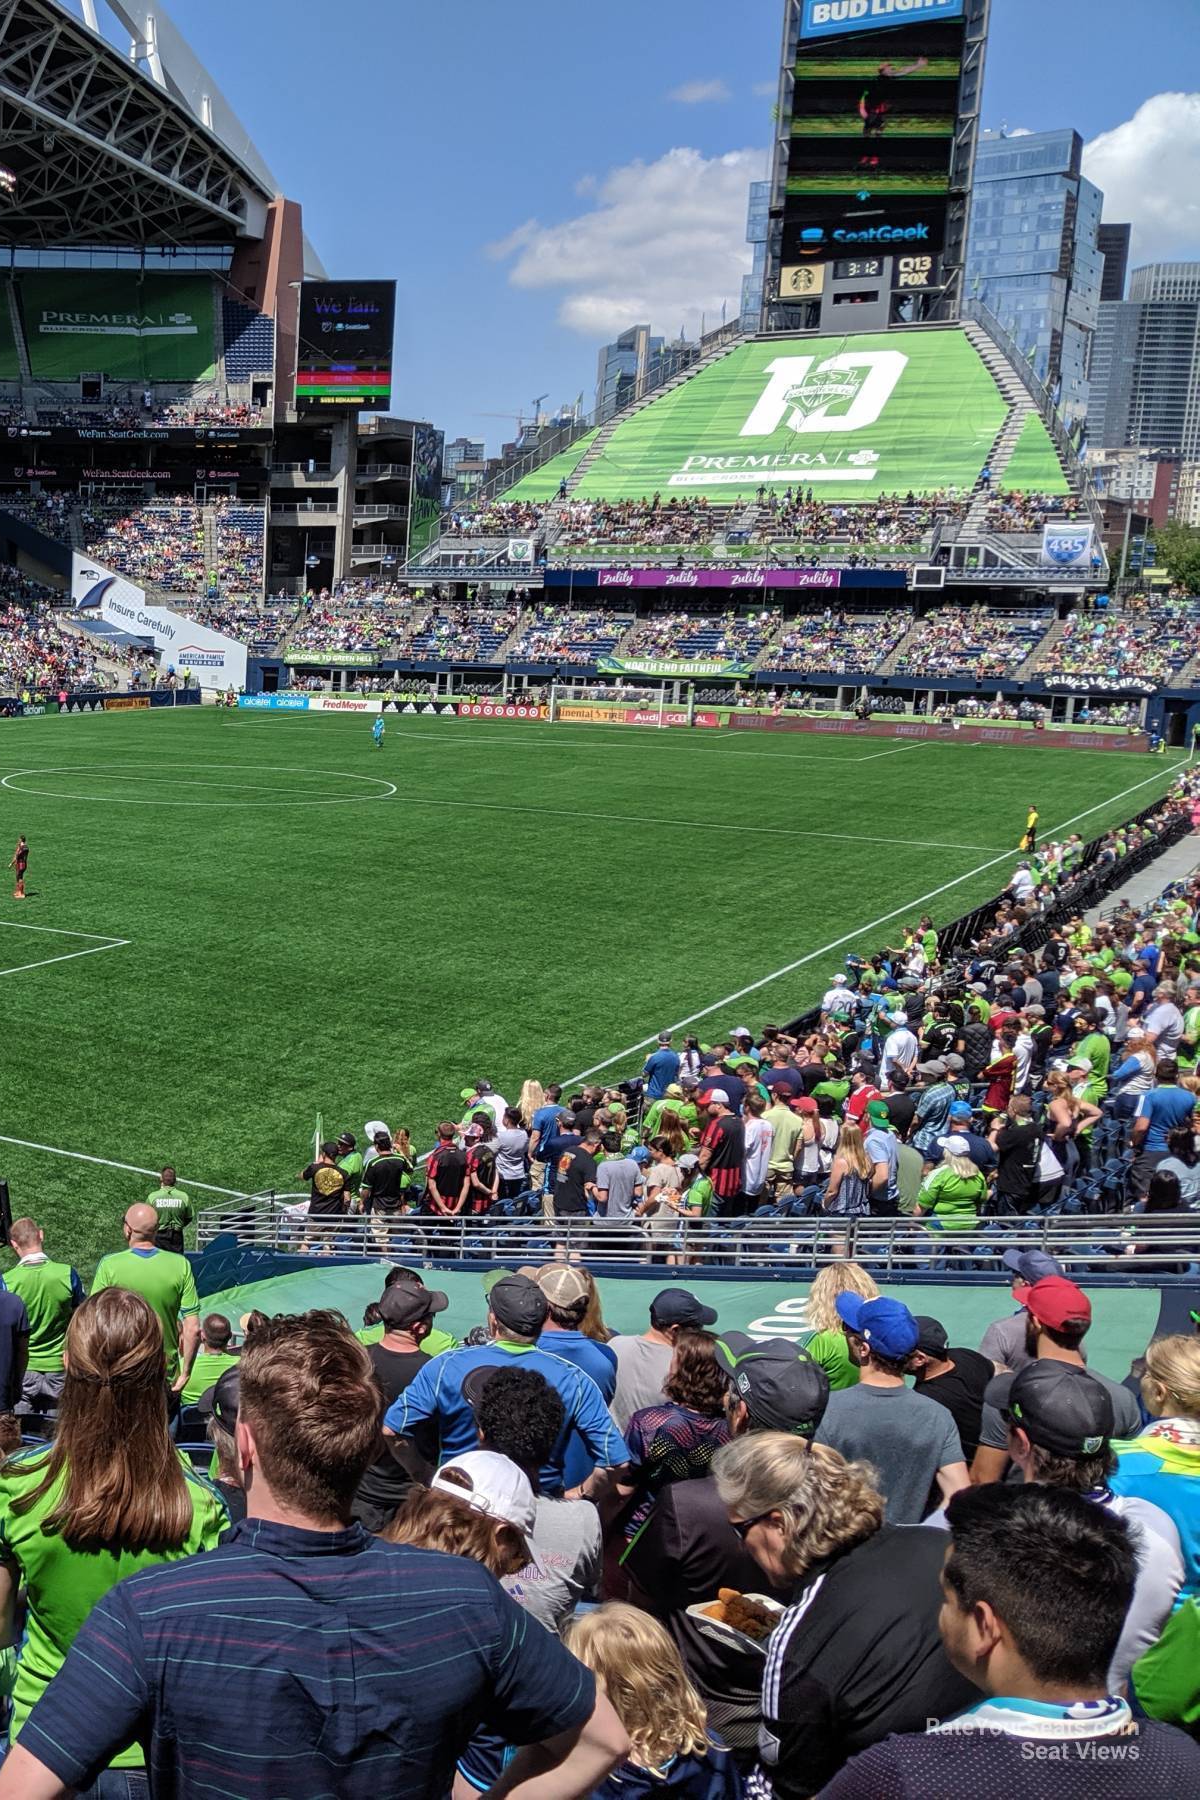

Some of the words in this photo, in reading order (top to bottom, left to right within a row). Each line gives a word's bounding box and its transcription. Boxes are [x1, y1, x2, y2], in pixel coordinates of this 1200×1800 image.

[812, 0, 868, 24] BUD
[832, 222, 929, 243] SeatGeek
[848, 260, 878, 276] 3:12
[898, 256, 932, 272] Q13
[898, 271, 929, 286] FOX
[40, 310, 156, 326] PREMERA
[738, 350, 910, 436] 10
[78, 428, 169, 440] WeFan.SeatGeek.com
[680, 453, 828, 471] PREMERA
[82, 469, 171, 480] WeFan.SeatGeek.com
[1049, 539, 1085, 552] 485
[602, 570, 634, 586] zulily
[666, 570, 698, 586] zulily
[731, 570, 765, 586] zulily
[800, 570, 834, 586] zulily
[108, 598, 136, 620] Insure
[137, 612, 176, 640] Carefully
[179, 652, 204, 660] AMERICAN
[288, 653, 318, 661] WELCOME
[624, 660, 657, 672] NORTH
[660, 662, 677, 672] END
[680, 662, 722, 673] FAITHFUL
[1044, 674, 1078, 690] DRINK
[1078, 676, 1110, 690] SING
[1110, 678, 1158, 693] SUPPORT
[322, 699, 340, 708] Fred
[341, 701, 368, 711] Meyer
[634, 712, 659, 721] Audi
[156, 1198, 182, 1208] SECURITY
